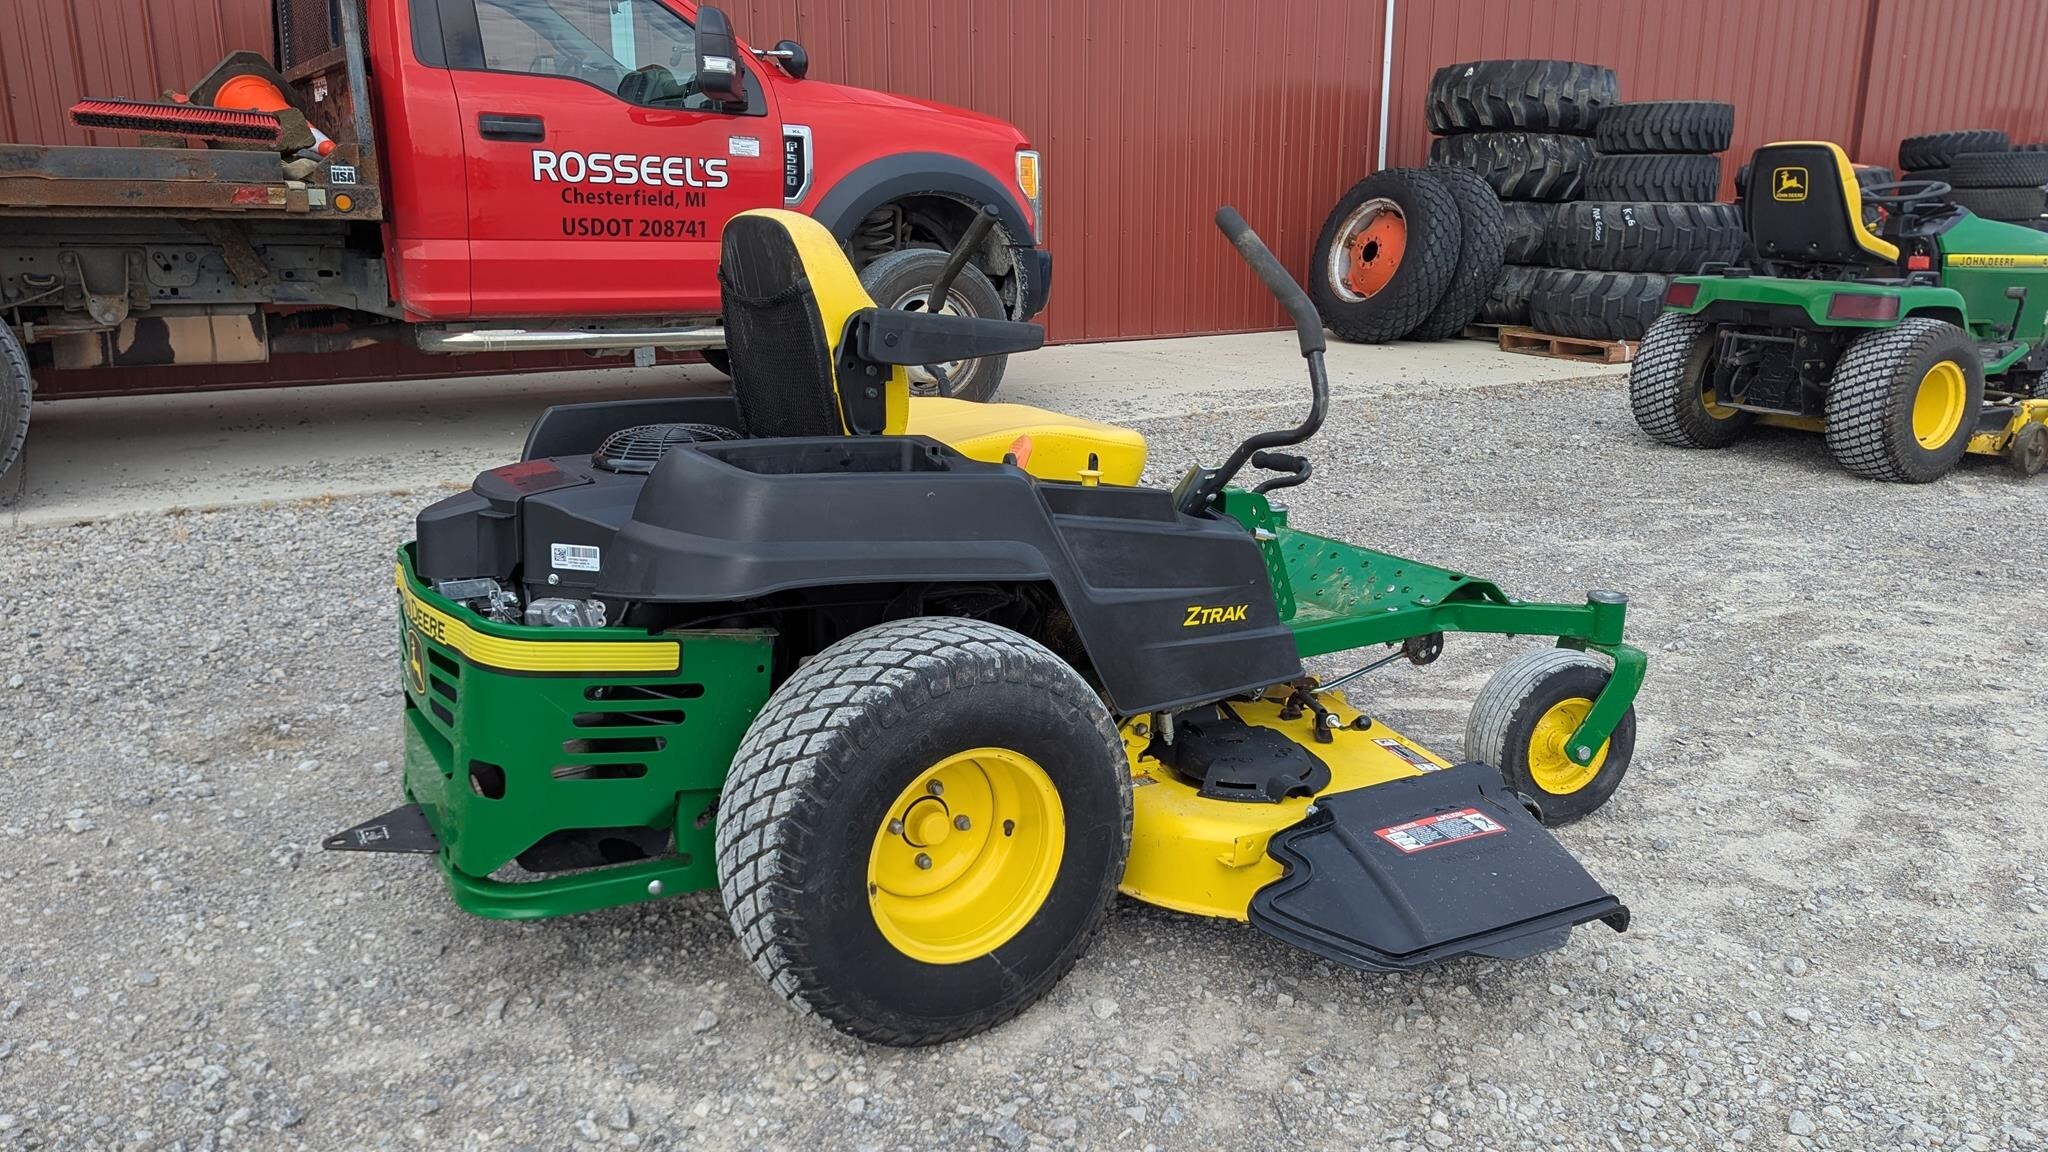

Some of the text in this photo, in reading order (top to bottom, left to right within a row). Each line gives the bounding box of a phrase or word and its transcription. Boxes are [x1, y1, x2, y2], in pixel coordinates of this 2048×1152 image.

[332, 171, 355, 183] USA
[531, 149, 729, 188] ROSSEEL'S
[561, 187, 706, 209] Chesterfield, MI
[562, 217, 706, 238] USDOT 208741
[1960, 256, 2015, 266] JOHN DEERE
[411, 599, 446, 641] DEERE
[1183, 604, 1249, 627] ZTRAK
